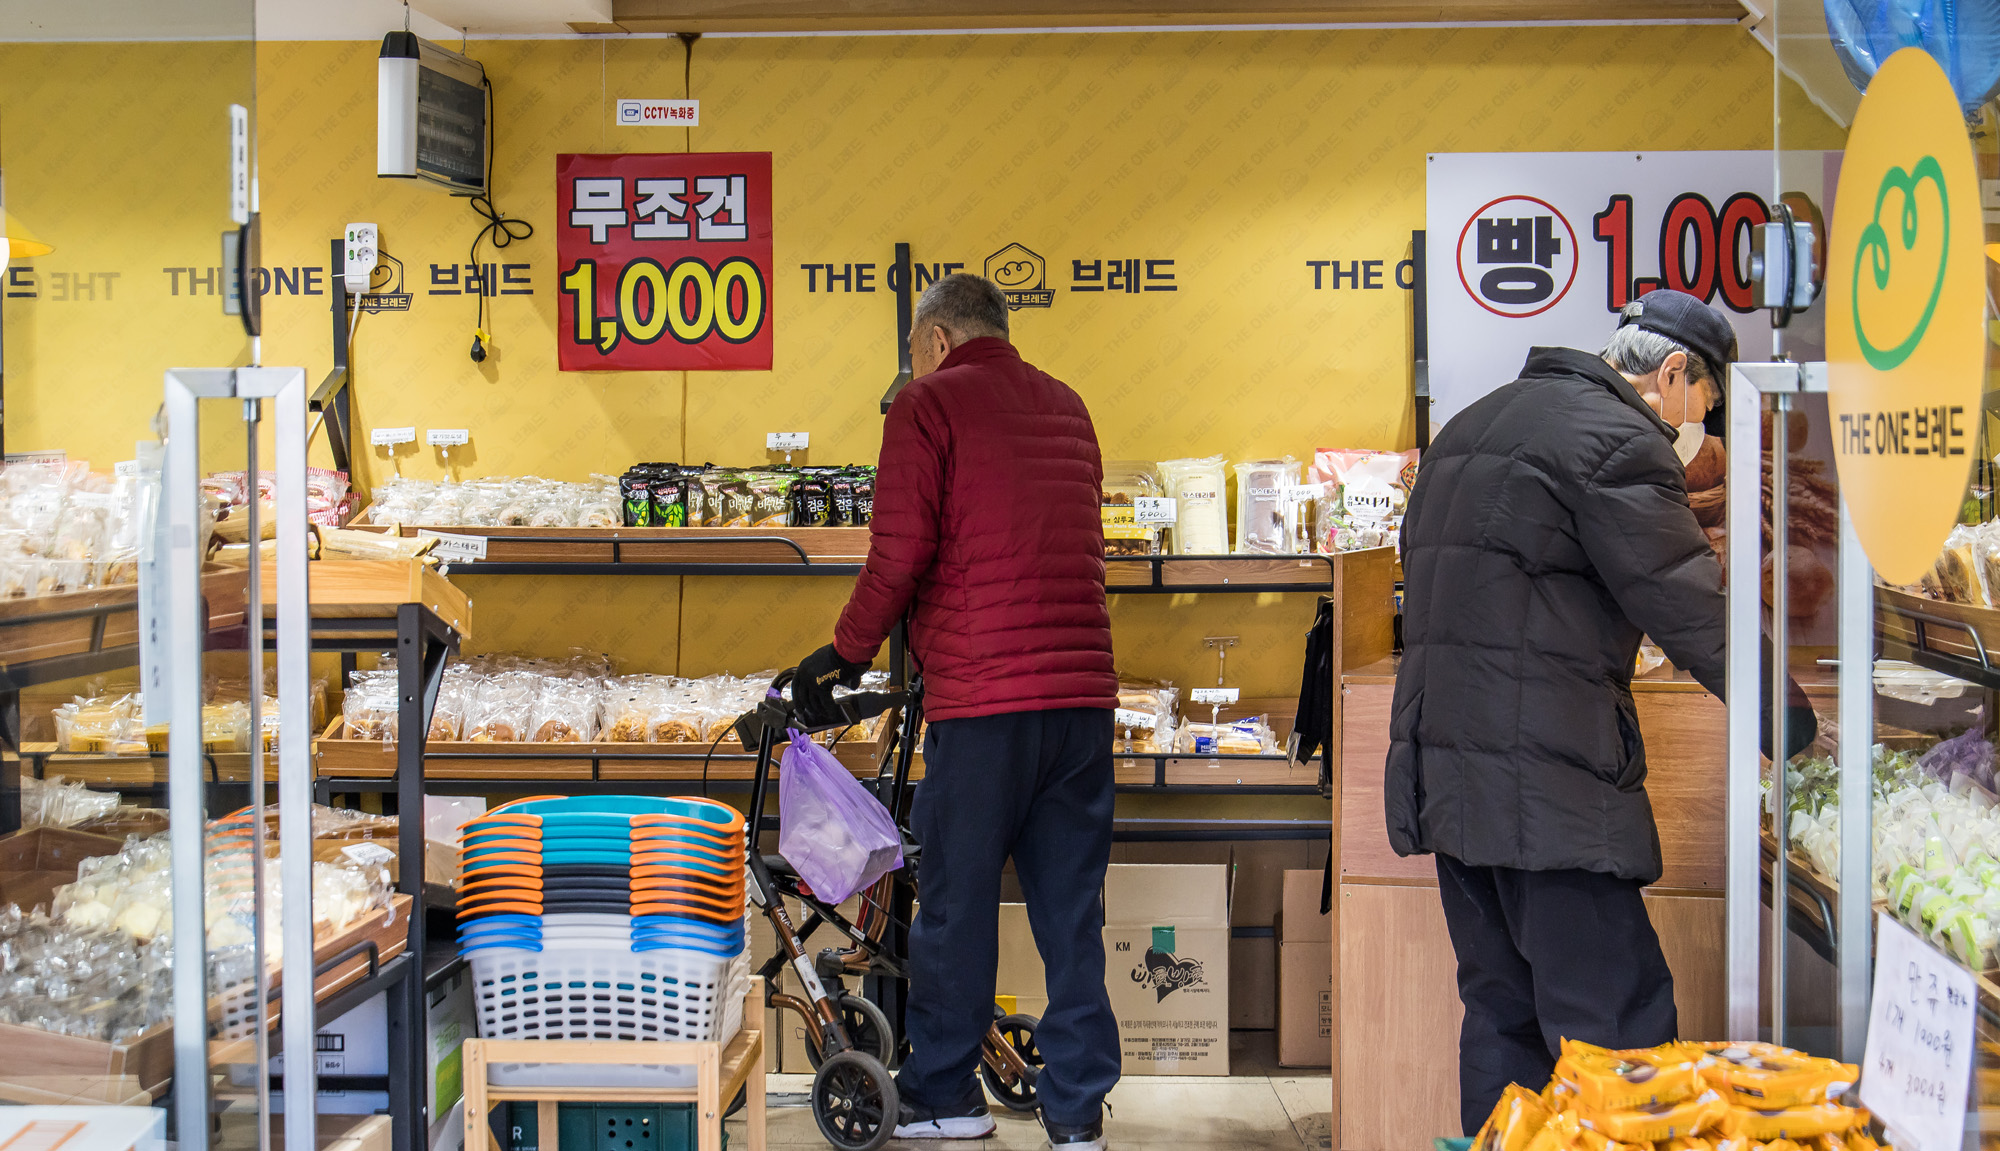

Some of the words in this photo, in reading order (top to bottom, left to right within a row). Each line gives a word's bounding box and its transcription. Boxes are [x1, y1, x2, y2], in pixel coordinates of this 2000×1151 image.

[643, 105, 695, 121] CCTV녹화중
[1104, 107, 1133, 134] THE
[1130, 83, 1159, 111] ONE
[1184, 78, 1223, 115] 브레드
[569, 175, 749, 243] 무조건
[801, 262, 876, 293] THE
[1070, 258, 1178, 294] 브레드
[1306, 260, 1385, 290] THE
[1476, 215, 1562, 306] 빵
[429, 263, 534, 297] 브레드
[379, 297, 408, 308] 브레드
[561, 256, 767, 356] 1,000
[1021, 294, 1049, 304] 브레드
[1839, 413, 1870, 455] THE
[1875, 411, 1909, 455] ONE
[1914, 405, 1964, 458] 브레드
[1115, 941, 1131, 952] KM
